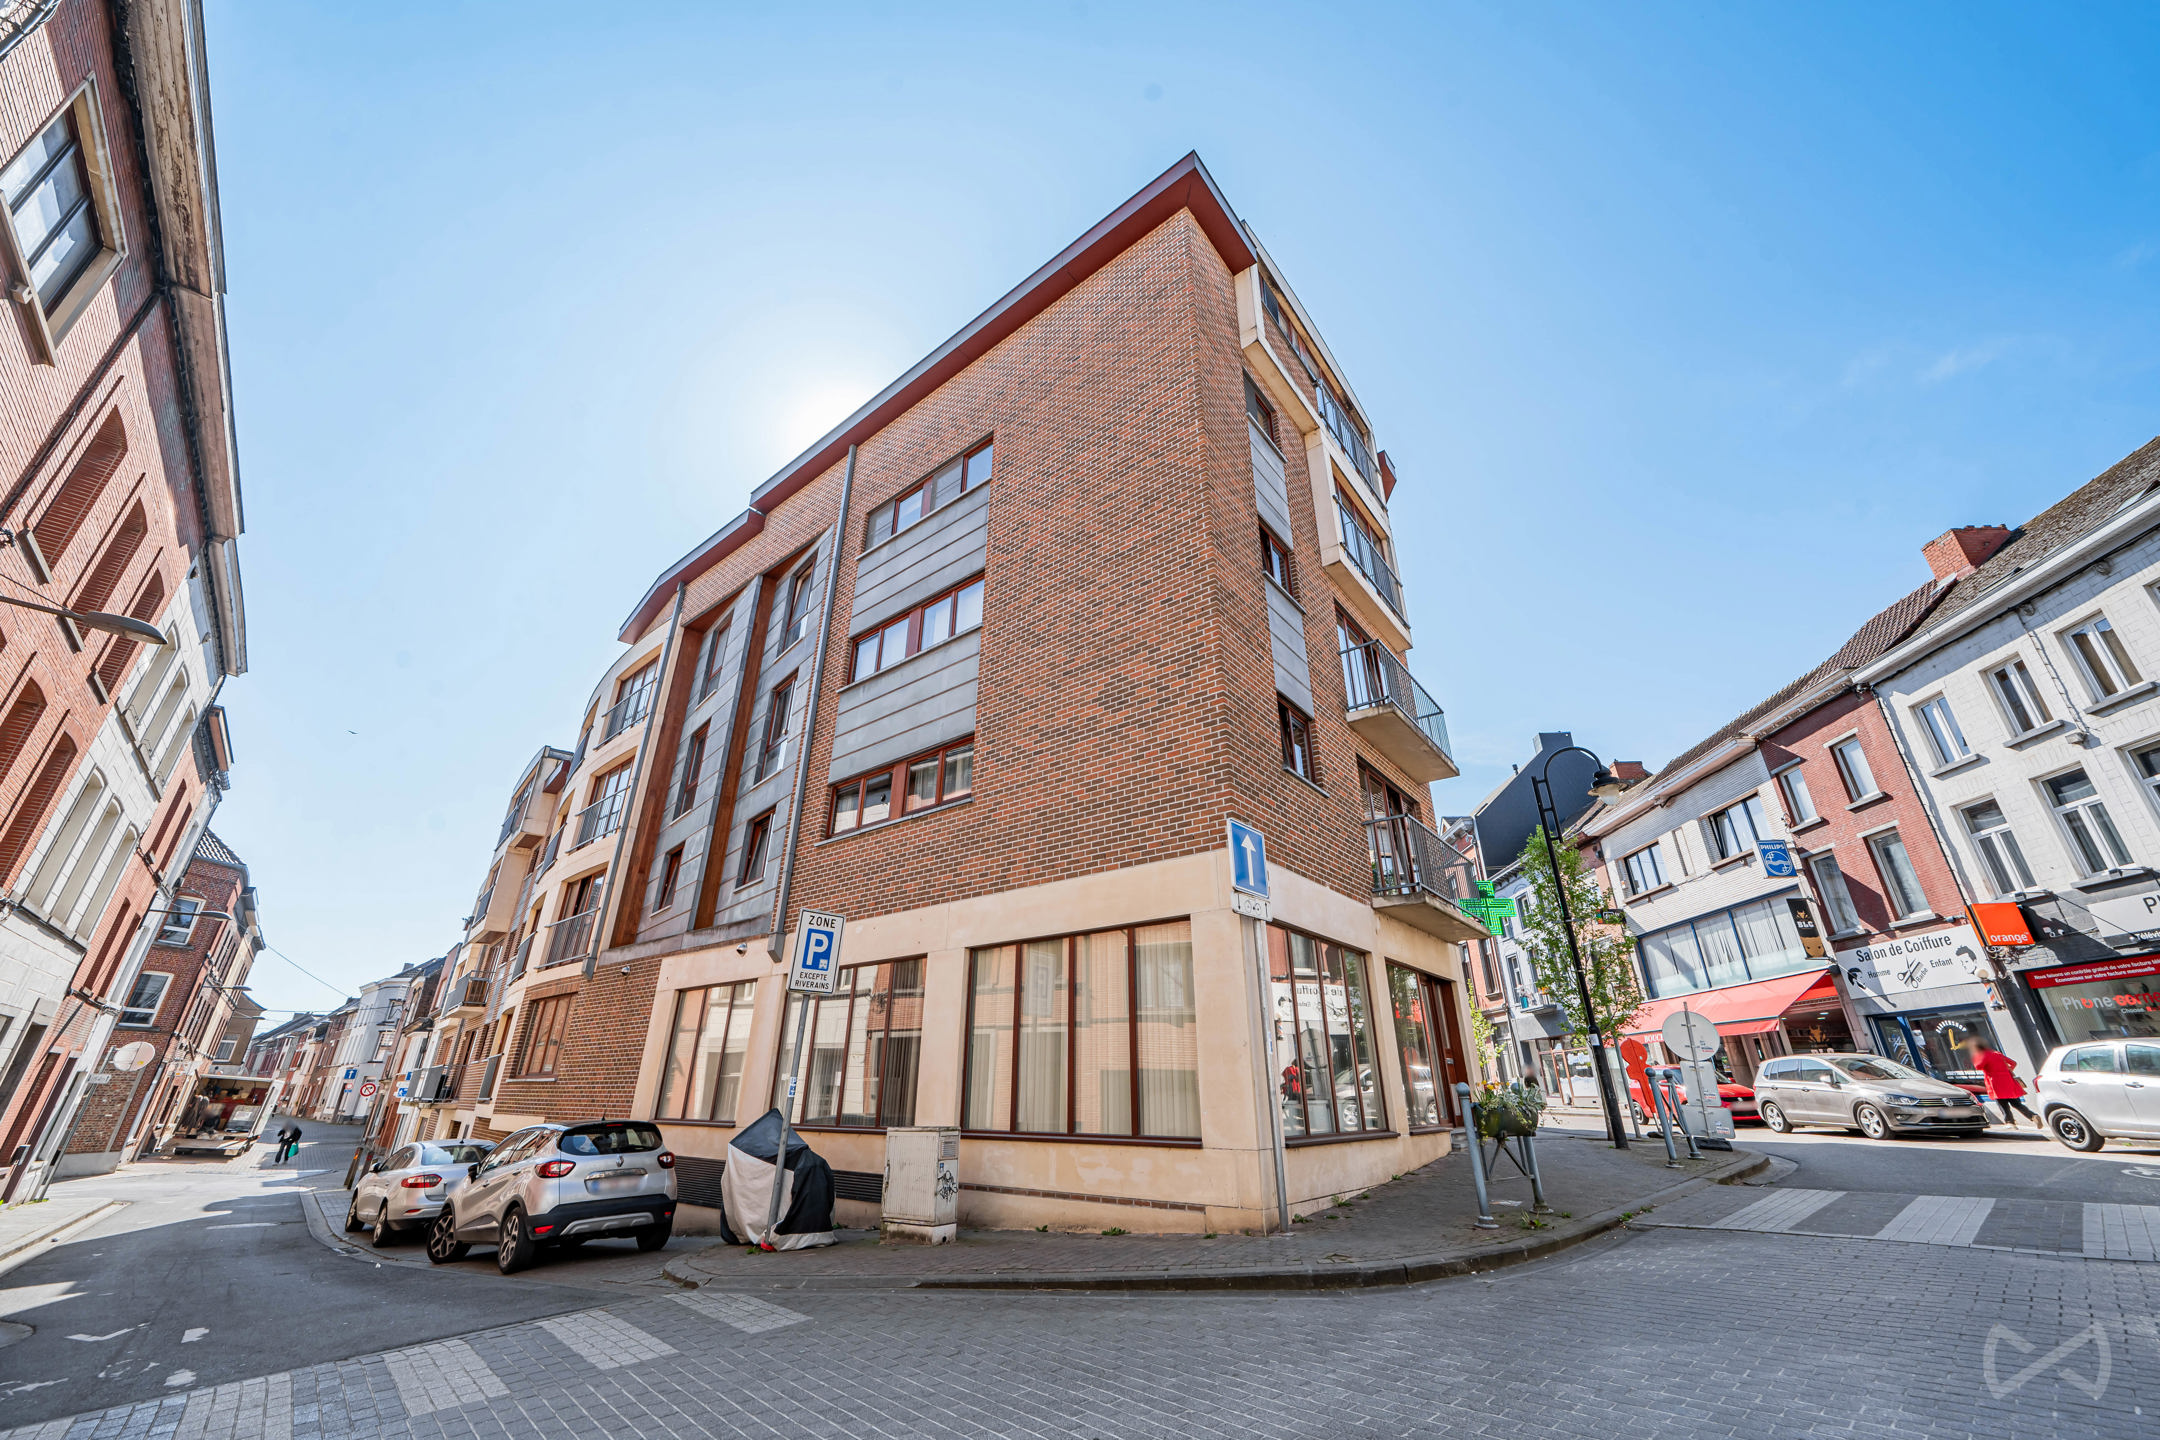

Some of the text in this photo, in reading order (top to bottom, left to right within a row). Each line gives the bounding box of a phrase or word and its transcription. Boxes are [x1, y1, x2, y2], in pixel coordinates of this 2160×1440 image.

[2143, 895, 2160, 914] P
[809, 915, 836, 928] ZONE
[1990, 934, 2028, 944] orange
[806, 932, 829, 965] P
[1856, 935, 1952, 962] Salon de Coiffure
[1929, 958, 1953, 968] Enfant
[800, 972, 827, 981] EXCEPTE
[1867, 968, 1891, 979] Homme
[1916, 967, 1928, 983] Barbe
[795, 980, 829, 990] RIVERAINS
